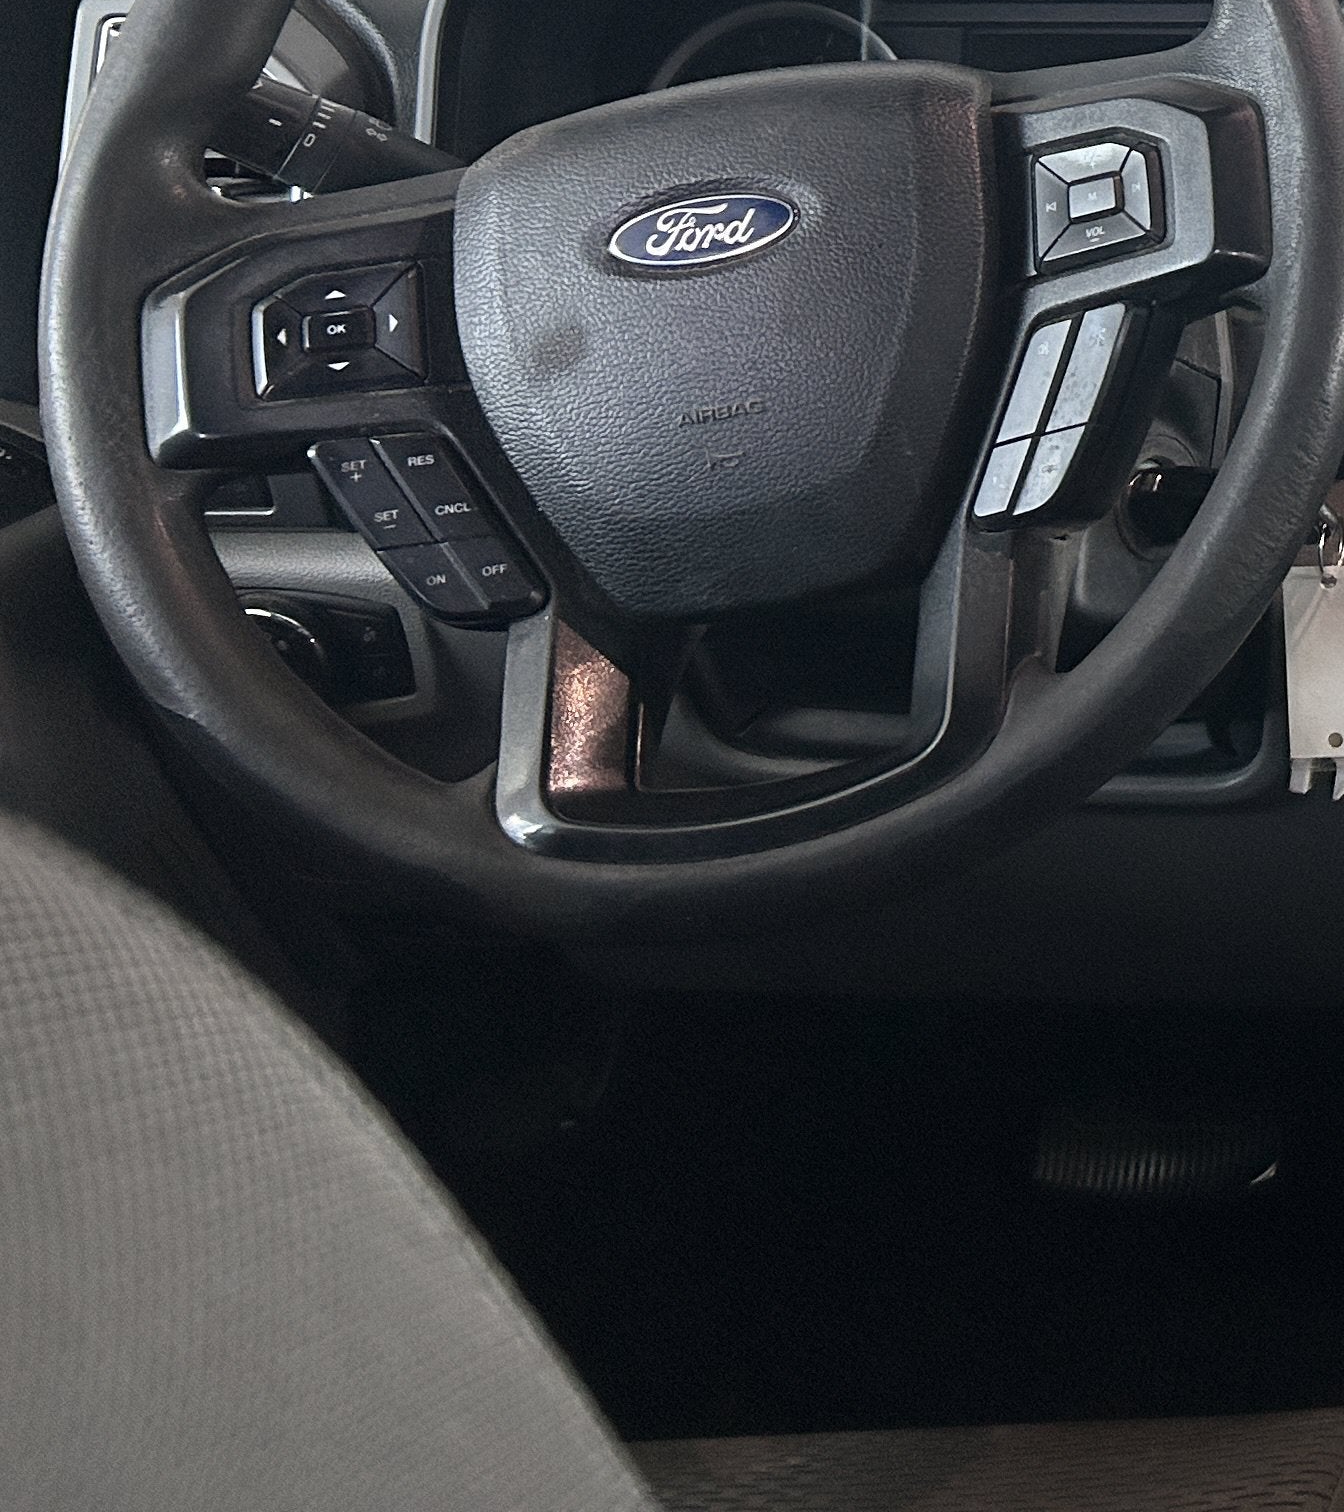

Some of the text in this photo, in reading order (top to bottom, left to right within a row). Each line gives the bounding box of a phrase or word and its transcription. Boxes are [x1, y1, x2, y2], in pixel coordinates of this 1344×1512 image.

[645, 202, 757, 256] Ford
[1085, 226, 1106, 238] VOL
[326, 324, 347, 335] OK
[340, 459, 367, 473] SET
[407, 454, 435, 467] RES
[374, 509, 399, 523] SET
[434, 502, 471, 516] CNCL
[482, 563, 508, 577] OFF
[426, 574, 446, 586] ON
